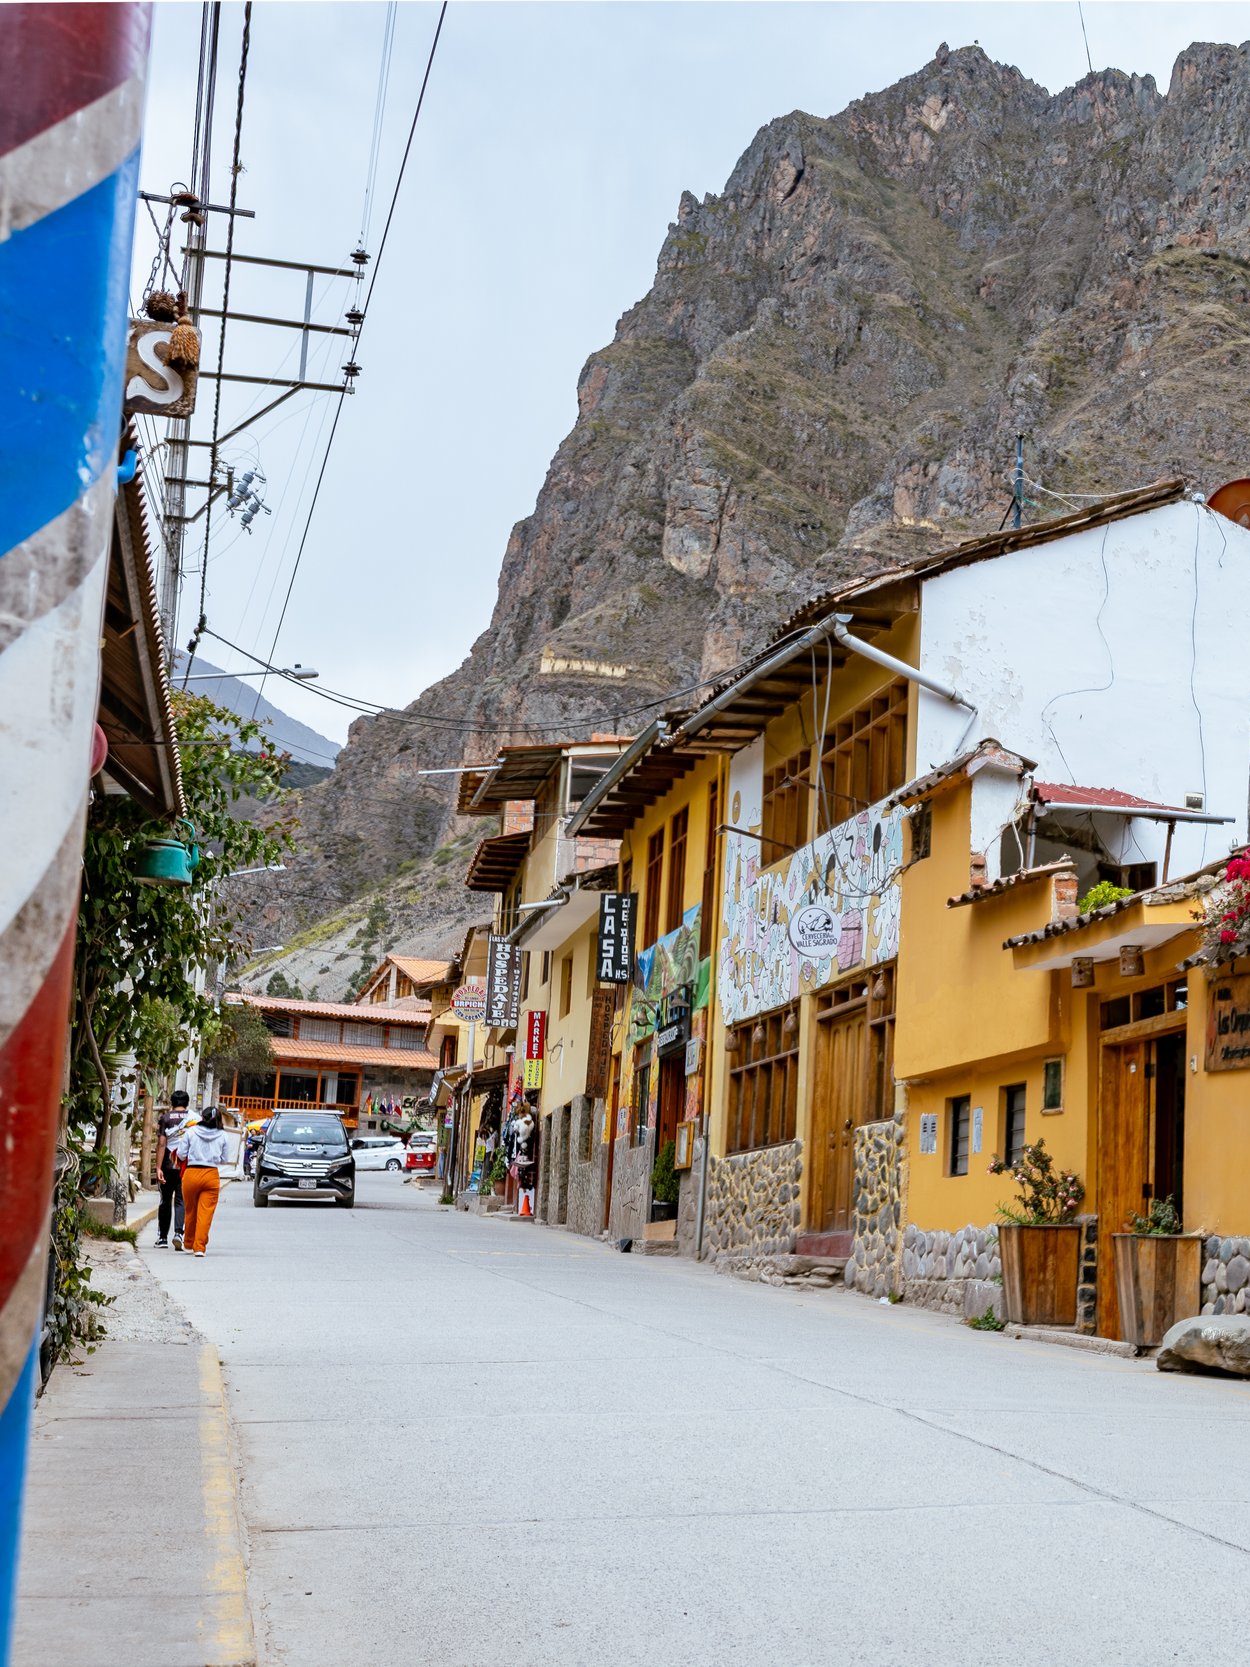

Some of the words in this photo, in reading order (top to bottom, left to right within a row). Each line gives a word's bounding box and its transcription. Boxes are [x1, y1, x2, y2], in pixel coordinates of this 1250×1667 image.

[601, 895, 616, 977] CASA
[813, 938, 837, 946] SAGRADO
[492, 943, 511, 1018] HOSPEDAJE
[532, 1012, 540, 1059] MARKET
[599, 995, 611, 1076] HOSPEDAJE
